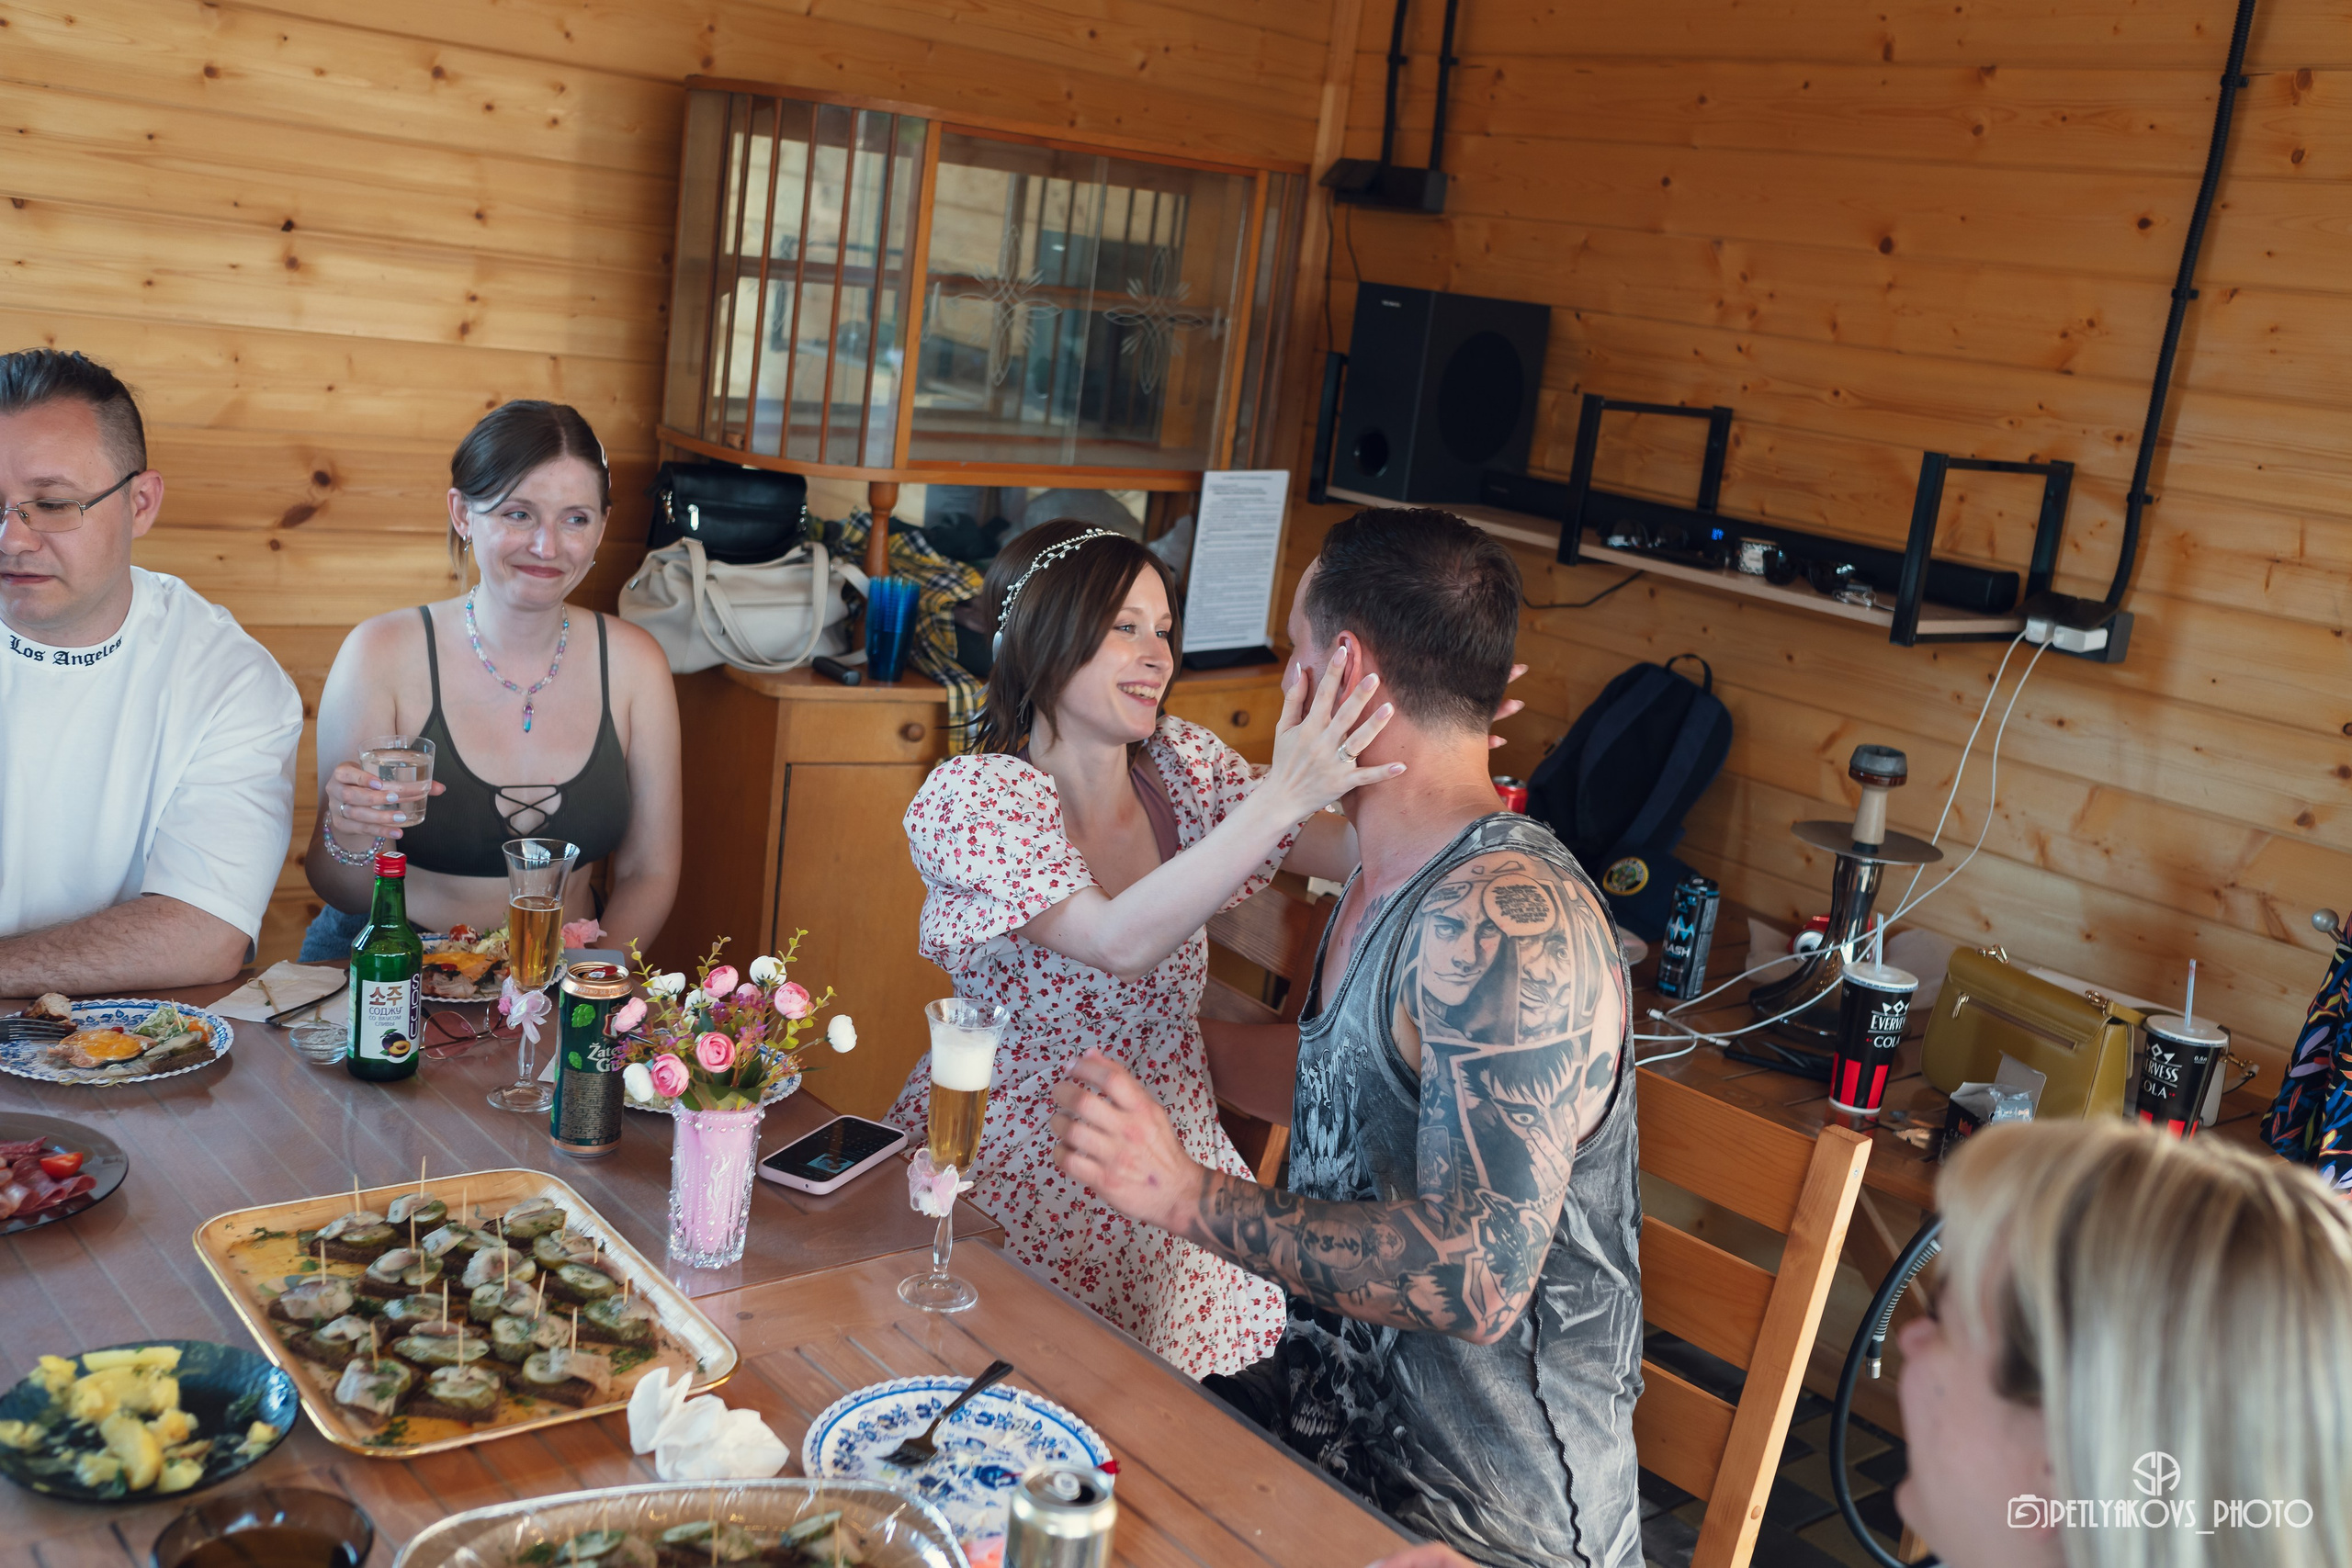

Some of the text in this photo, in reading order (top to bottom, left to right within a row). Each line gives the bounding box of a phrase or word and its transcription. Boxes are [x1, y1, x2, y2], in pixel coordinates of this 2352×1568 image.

[9, 635, 122, 667] Los Angeles
[368, 986, 403, 1006] 소주
[411, 973, 420, 1037] SOJU
[368, 1007, 403, 1016] СОДЖУ
